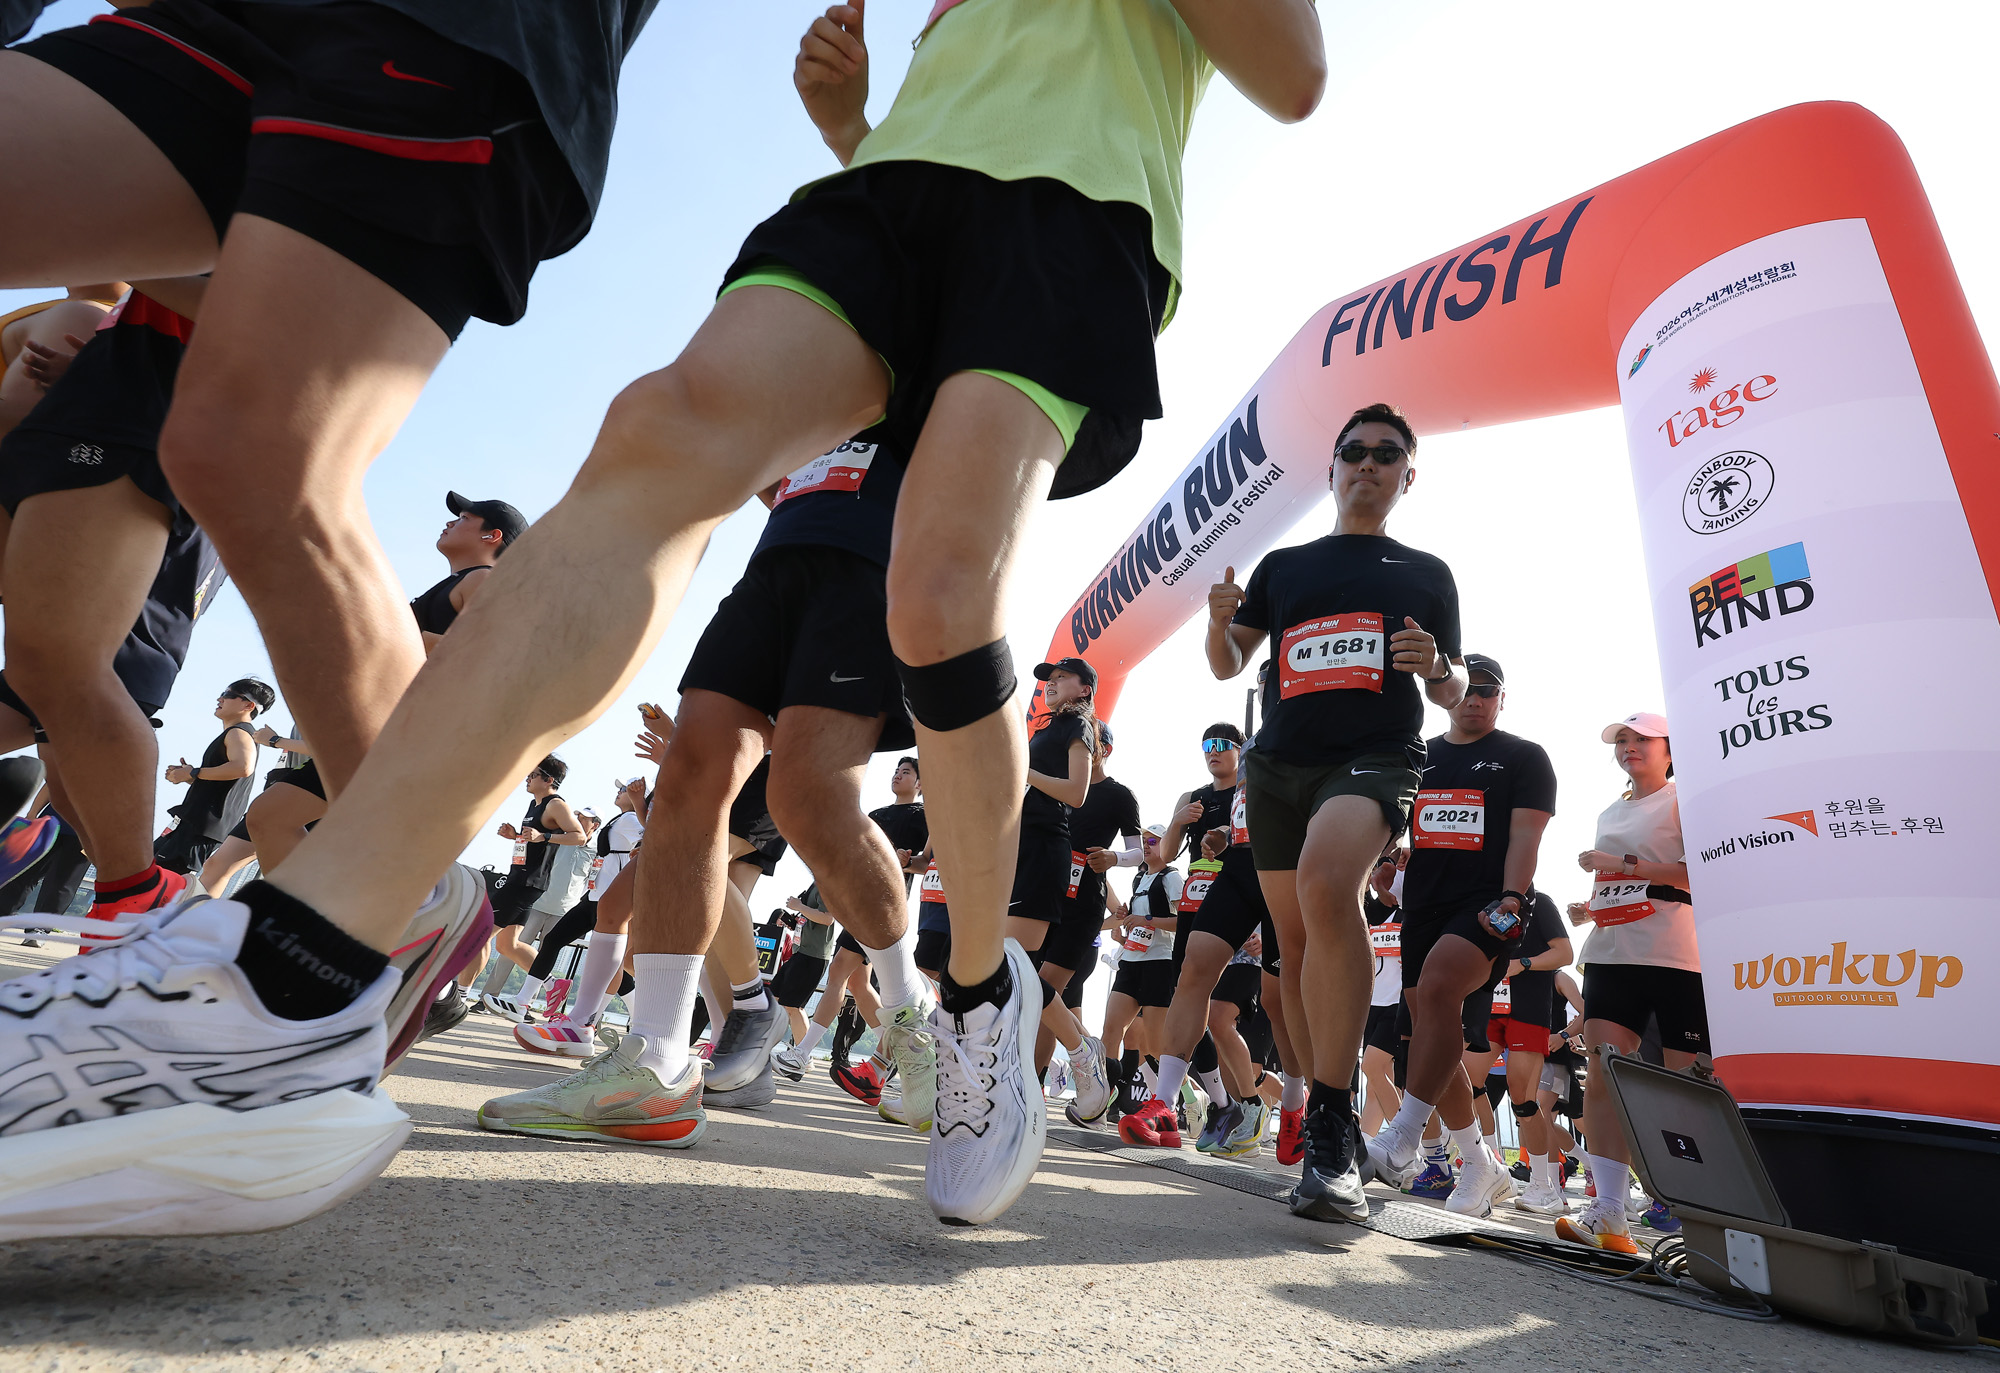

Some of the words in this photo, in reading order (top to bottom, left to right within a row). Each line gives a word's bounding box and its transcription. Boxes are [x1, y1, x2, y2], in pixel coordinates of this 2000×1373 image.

[1322, 195, 1596, 367] FINISH
[1687, 308, 1708, 324] ISLAND
[1708, 290, 1746, 311] EXHIBITION
[1746, 281, 1770, 293] YEOSU
[1771, 272, 1797, 283] KOREA
[1690, 455, 1757, 496] SUNBODY
[1072, 502, 1182, 656] BURNING
[1184, 394, 1267, 536] RUN
[1162, 552, 1197, 586] Casual
[1192, 511, 1241, 557] Running
[1232, 463, 1285, 514] Festival
[1701, 497, 1759, 530] TANNING
[1320, 619, 1340, 629] RUN
[1693, 580, 1814, 648] KIND
[1296, 647, 1312, 660] M
[1319, 638, 1377, 657] 1681
[1714, 655, 1810, 702] TOUS
[1747, 693, 1778, 717] les
[1718, 704, 1833, 760] JOURS
[1423, 812, 1433, 821] M
[1436, 810, 1478, 823] 2021
[1824, 797, 1886, 817] 후원을
[1701, 838, 1736, 863] World
[1738, 830, 1795, 850] Vision
[1600, 884, 1647, 897] 4125
[1132, 928, 1152, 941] 3564
[1776, 994, 1833, 1003] OUTDOOR
[1840, 994, 1894, 1003] OUTLET
[1677, 1138, 1686, 1150] 3
